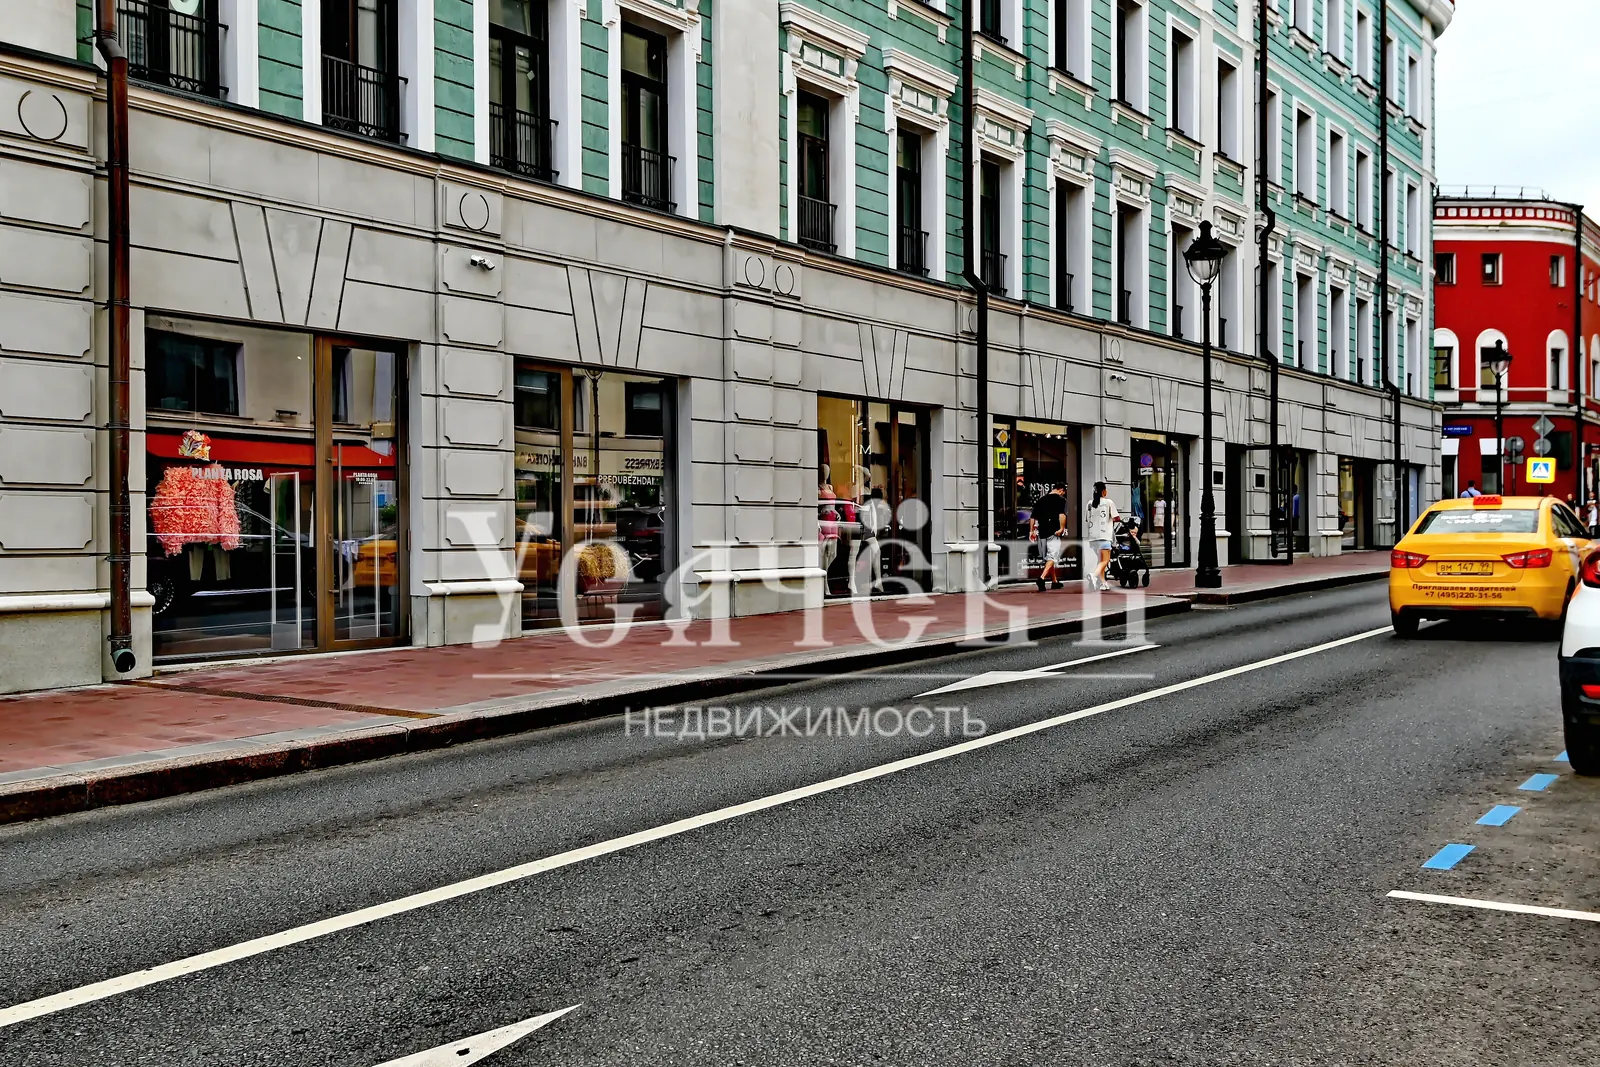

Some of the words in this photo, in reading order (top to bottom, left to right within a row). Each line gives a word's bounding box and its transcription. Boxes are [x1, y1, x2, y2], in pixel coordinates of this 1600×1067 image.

[191, 467, 233, 480] PLANTA
[233, 468, 264, 481] ROSA
[1458, 562, 1474, 572] 147
[1412, 583, 1467, 592] Приглашаем
